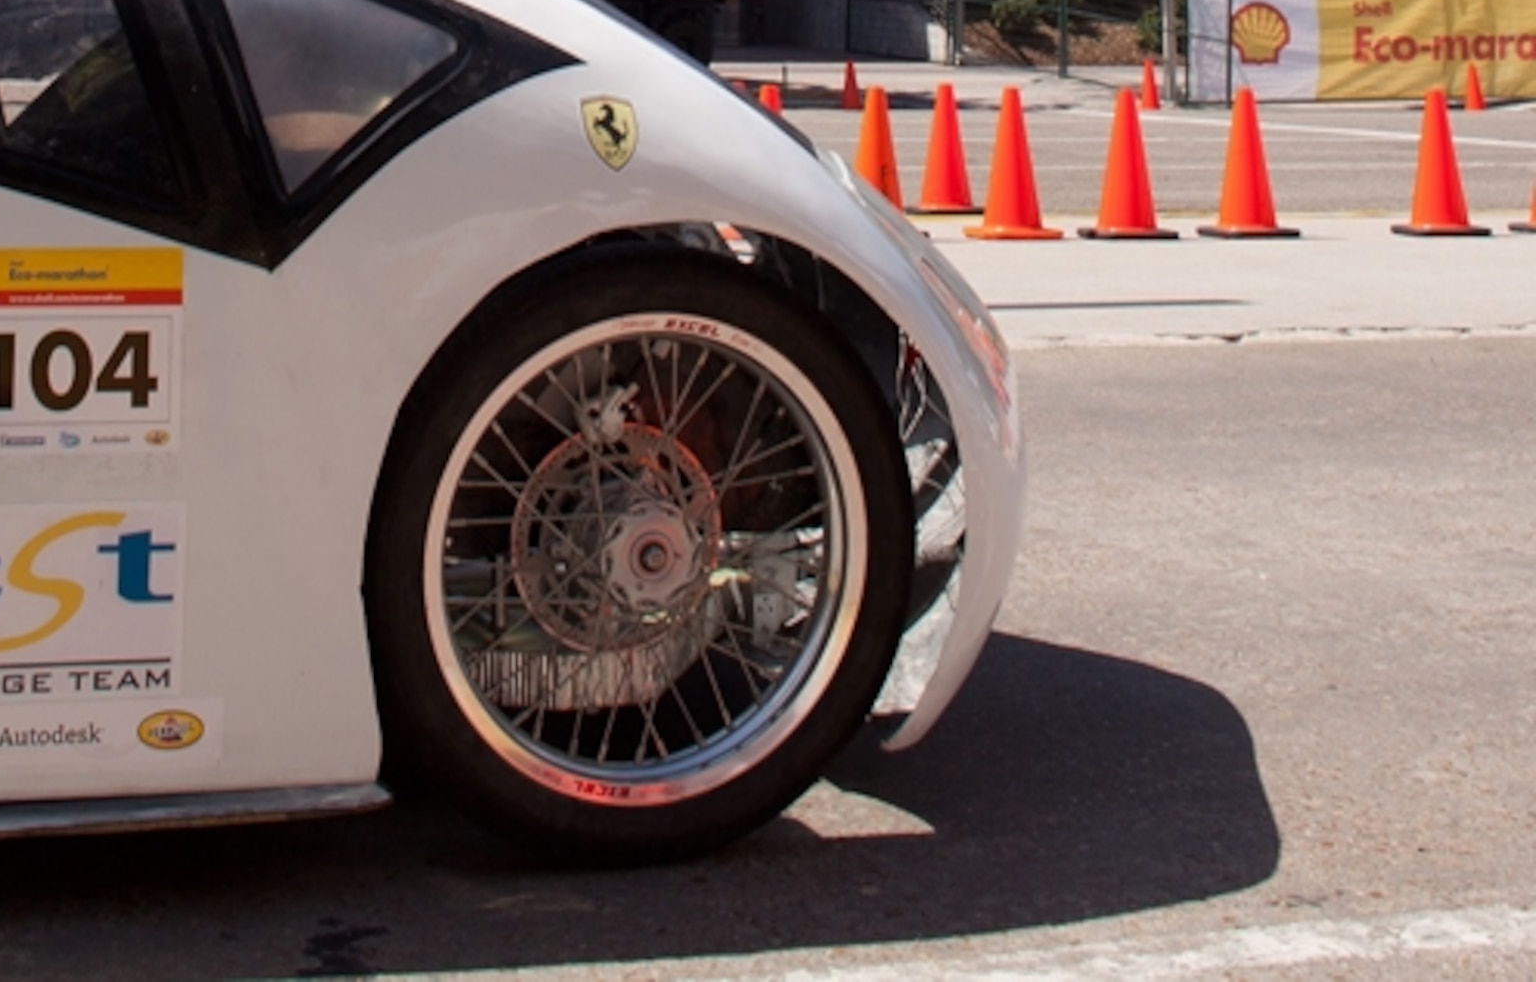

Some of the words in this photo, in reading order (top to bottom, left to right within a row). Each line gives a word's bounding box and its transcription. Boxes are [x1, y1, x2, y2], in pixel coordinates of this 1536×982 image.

[1352, 0, 1393, 17] Shell
[665, 318, 720, 337] EXCEL
[68, 668, 171, 691] TEAM
